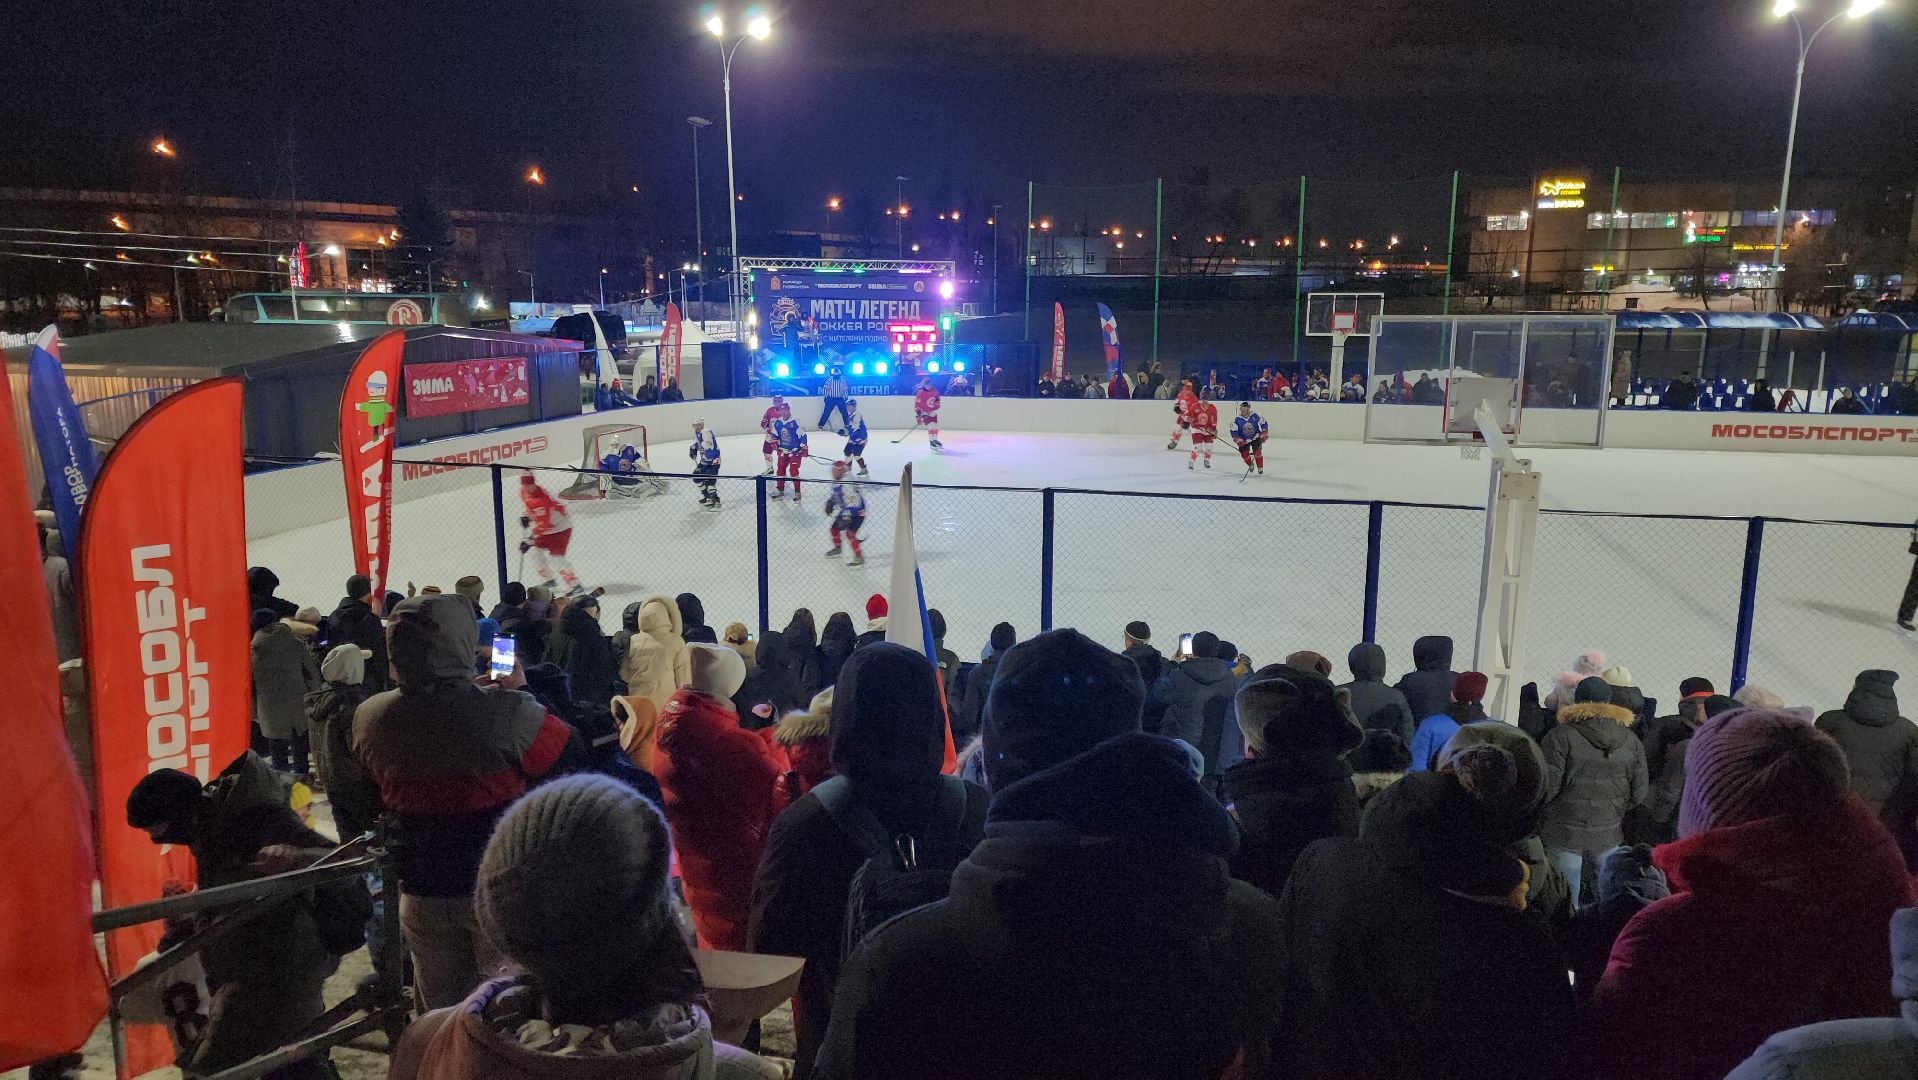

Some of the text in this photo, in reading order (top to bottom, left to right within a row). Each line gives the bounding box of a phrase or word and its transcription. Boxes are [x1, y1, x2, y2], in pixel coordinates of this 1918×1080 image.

[810, 299, 921, 321] МАТЧ ЛЕГЕНД
[864, 335, 888, 343] ПОДМО
[413, 377, 454, 395] ЗИМА
[1711, 424, 1914, 442] МОСОБЛСПОРТ
[402, 438, 532, 481] МОСОБЛСПОРТ
